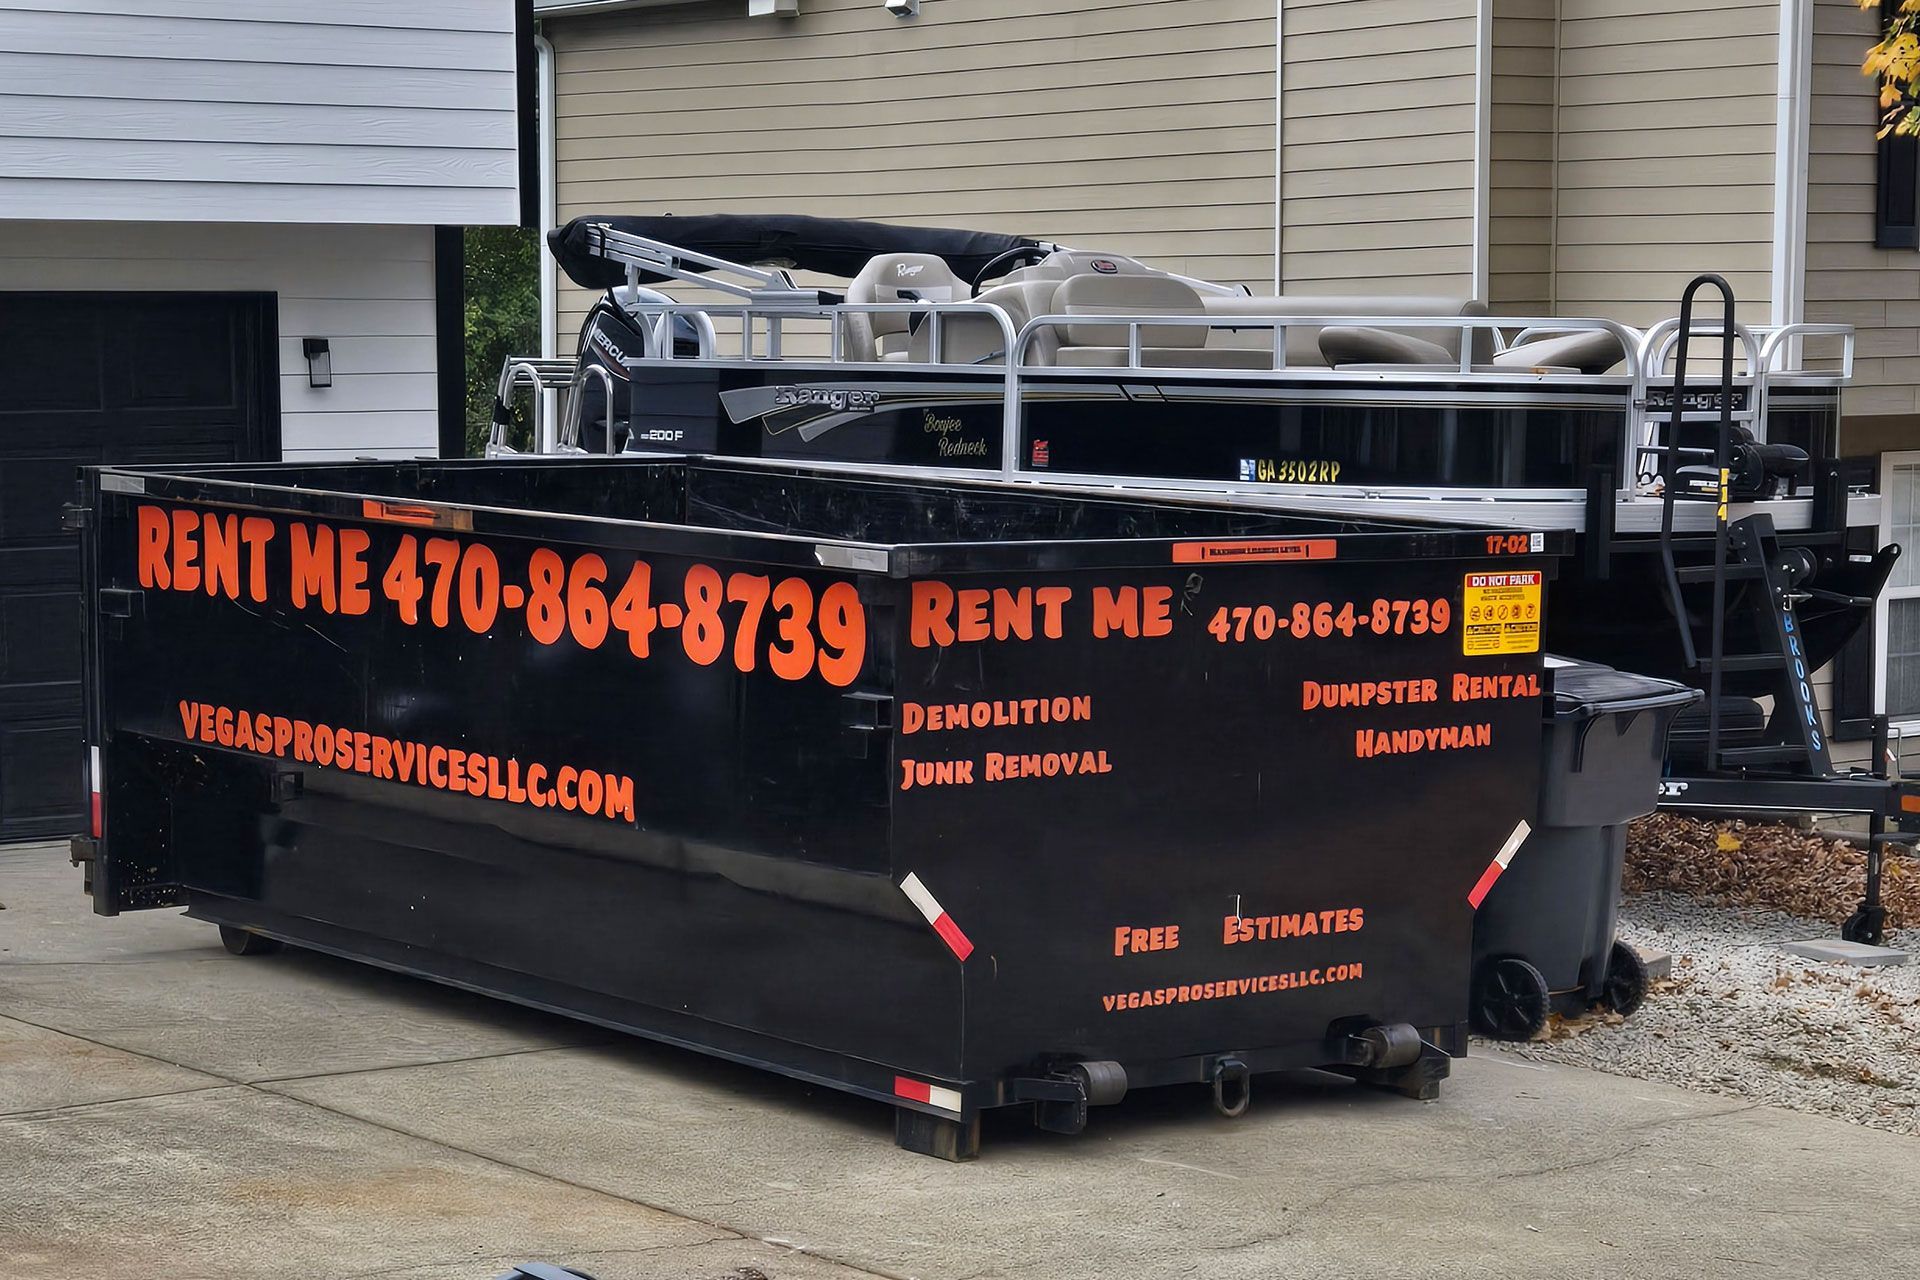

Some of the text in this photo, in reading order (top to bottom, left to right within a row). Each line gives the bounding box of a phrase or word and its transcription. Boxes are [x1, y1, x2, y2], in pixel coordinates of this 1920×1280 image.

[593, 328, 627, 365] MERCU
[775, 386, 880, 411] Ranger
[938, 437, 987, 457] Redneck
[1486, 535, 1528, 554] 17-02
[138, 505, 867, 687] RENT ME 470-864-8739
[1472, 574, 1535, 586] DO NOT PARK
[910, 580, 1173, 648] RENT ME
[1207, 597, 1451, 643] 470-864-8739
[1302, 672, 1541, 711] DUMPSTER RENTAL
[1782, 612, 1822, 751] BROOKS
[902, 695, 1091, 735] DEMOLITION
[1355, 723, 1491, 758] HANDYMAN
[178, 699, 636, 823] VEGASPROSERVICESLLC.COM
[901, 750, 1113, 790] JUNK REMOVAL
[1114, 907, 1364, 956] FREE ESTIMATES
[1102, 962, 1363, 1012] VEGASPROSERVICESLLC.COM
